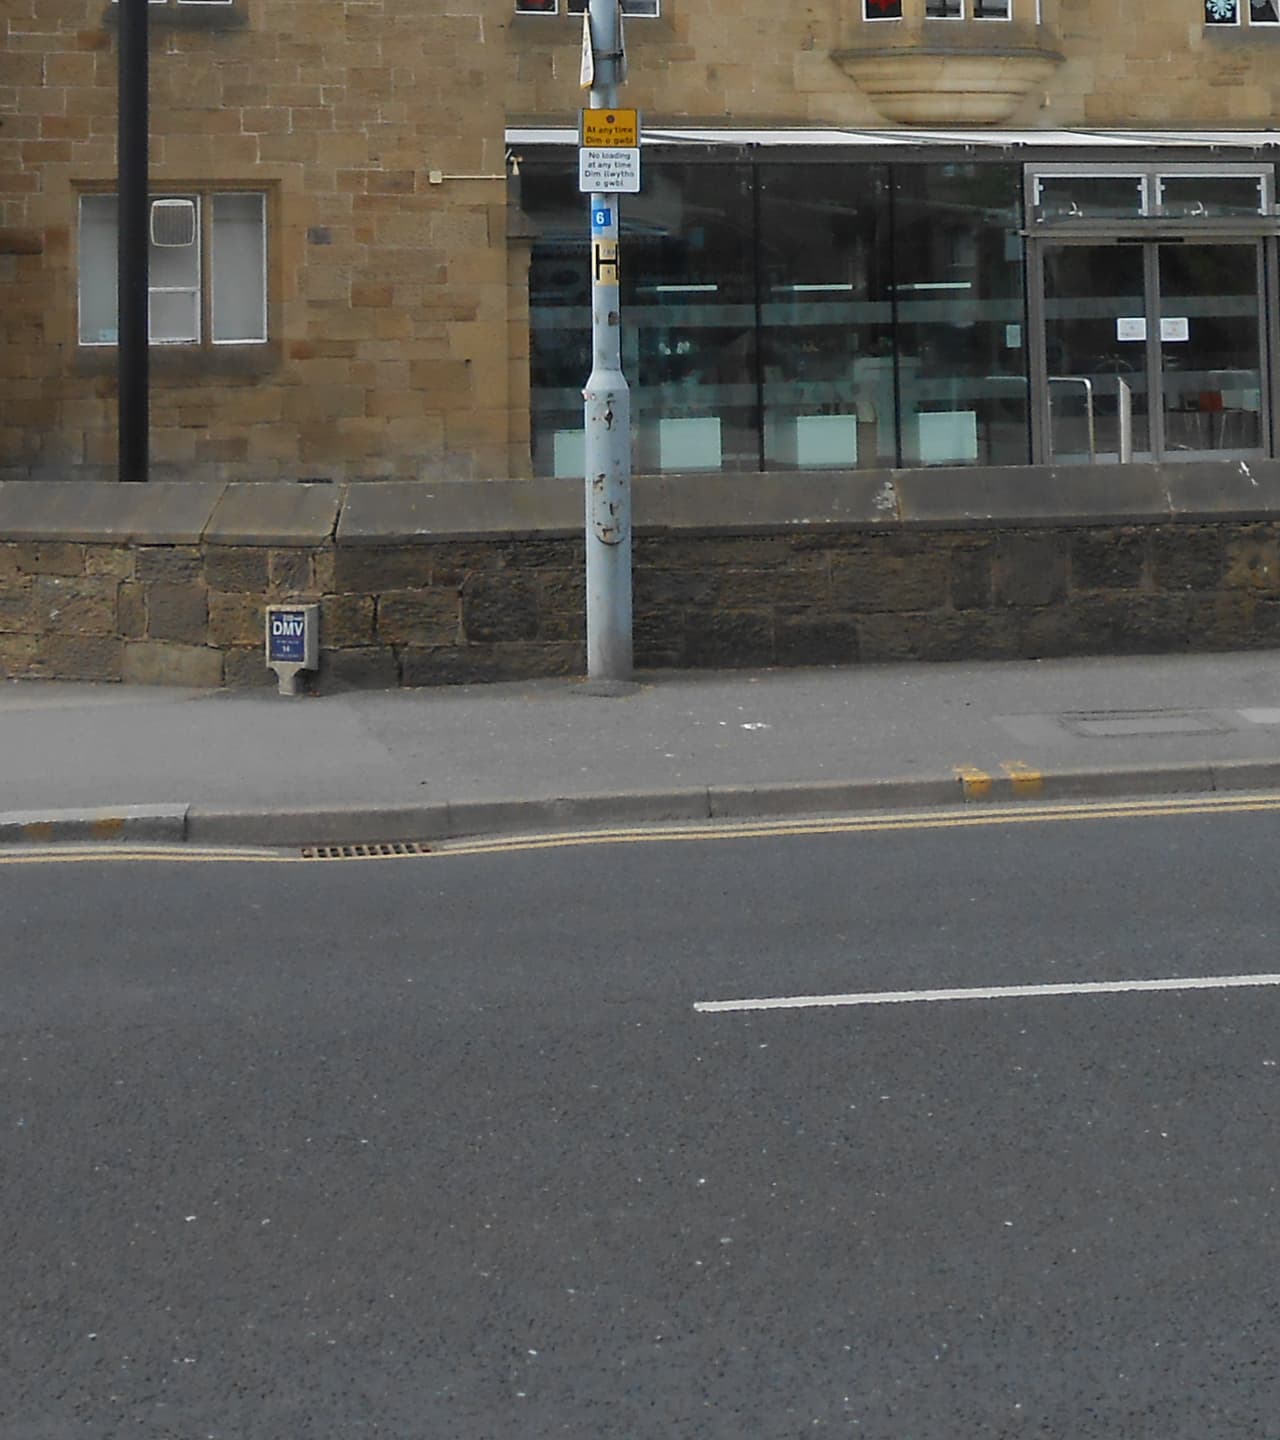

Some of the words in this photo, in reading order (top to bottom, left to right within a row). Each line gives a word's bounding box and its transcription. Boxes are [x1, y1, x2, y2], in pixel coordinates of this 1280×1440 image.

[599, 127, 613, 135] any
[586, 136, 602, 145] Dim
[602, 152, 631, 161] loading
[596, 211, 605, 225] 6
[273, 621, 304, 636] DMV
